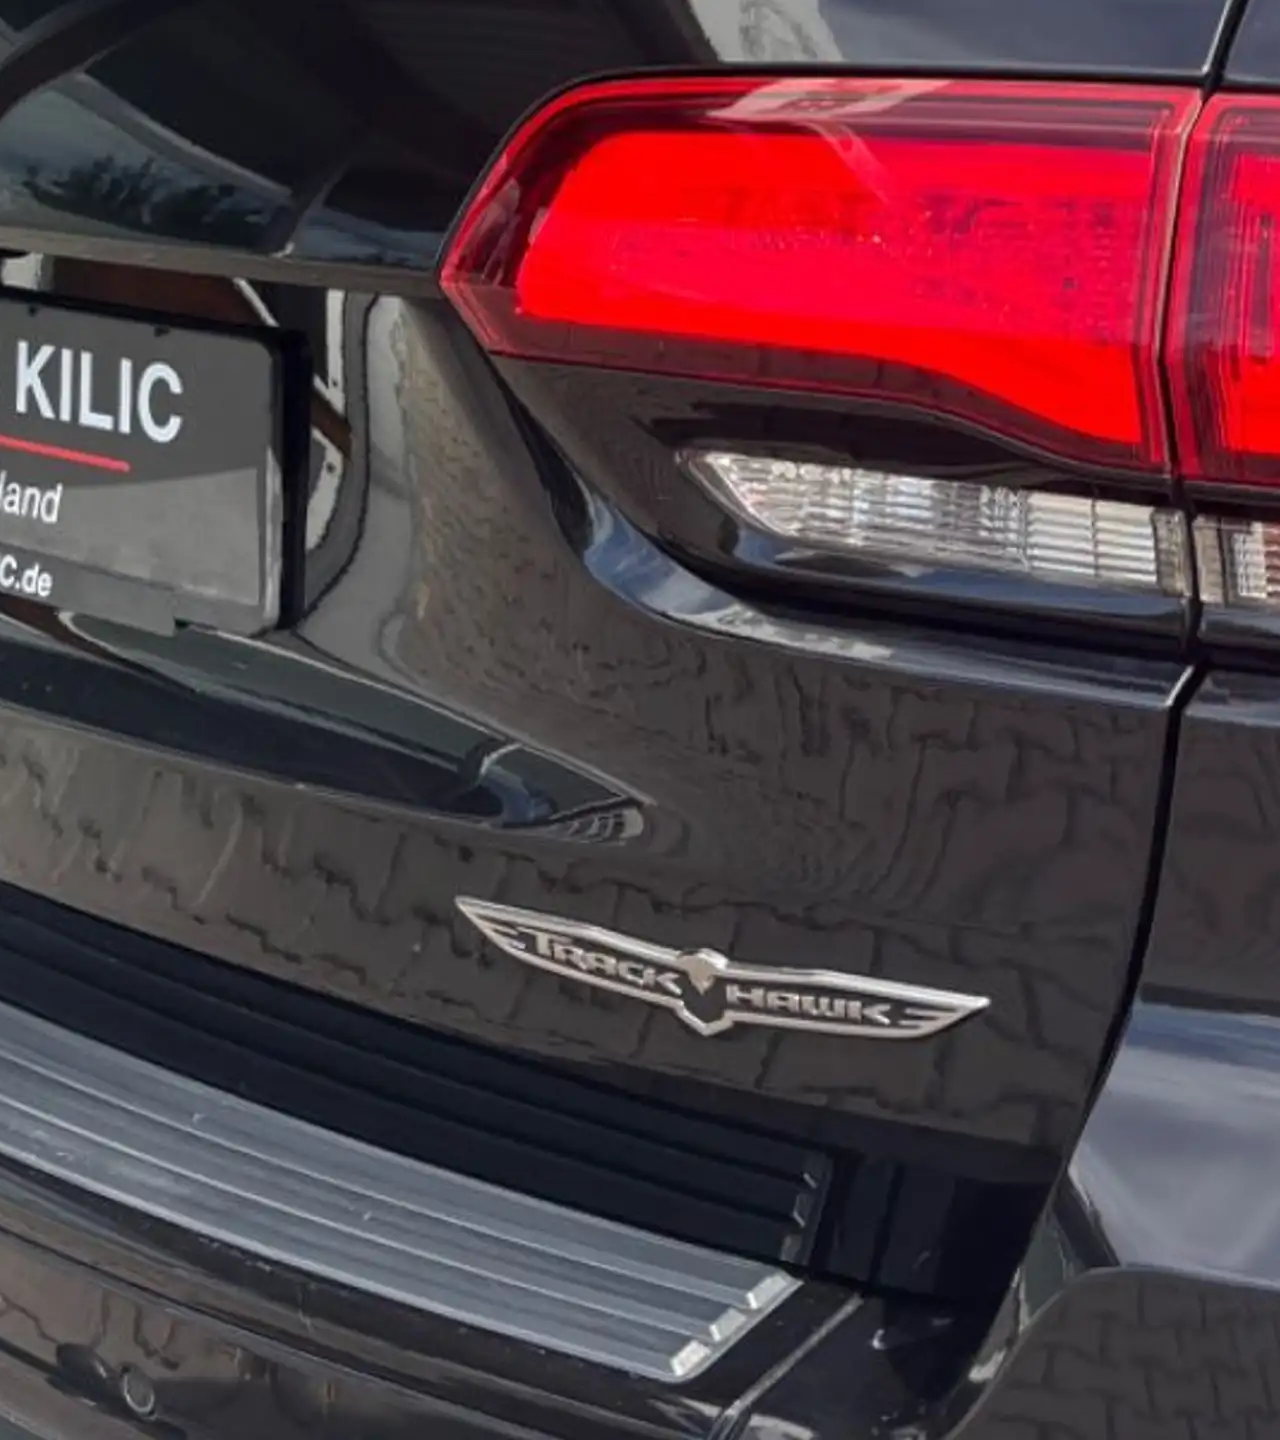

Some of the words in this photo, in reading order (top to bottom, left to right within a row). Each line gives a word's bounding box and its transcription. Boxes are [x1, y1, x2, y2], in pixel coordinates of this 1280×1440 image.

[15, 339, 183, 443] KILIC
[522, 927, 683, 995] TRACK
[725, 982, 892, 1027] HAWK
